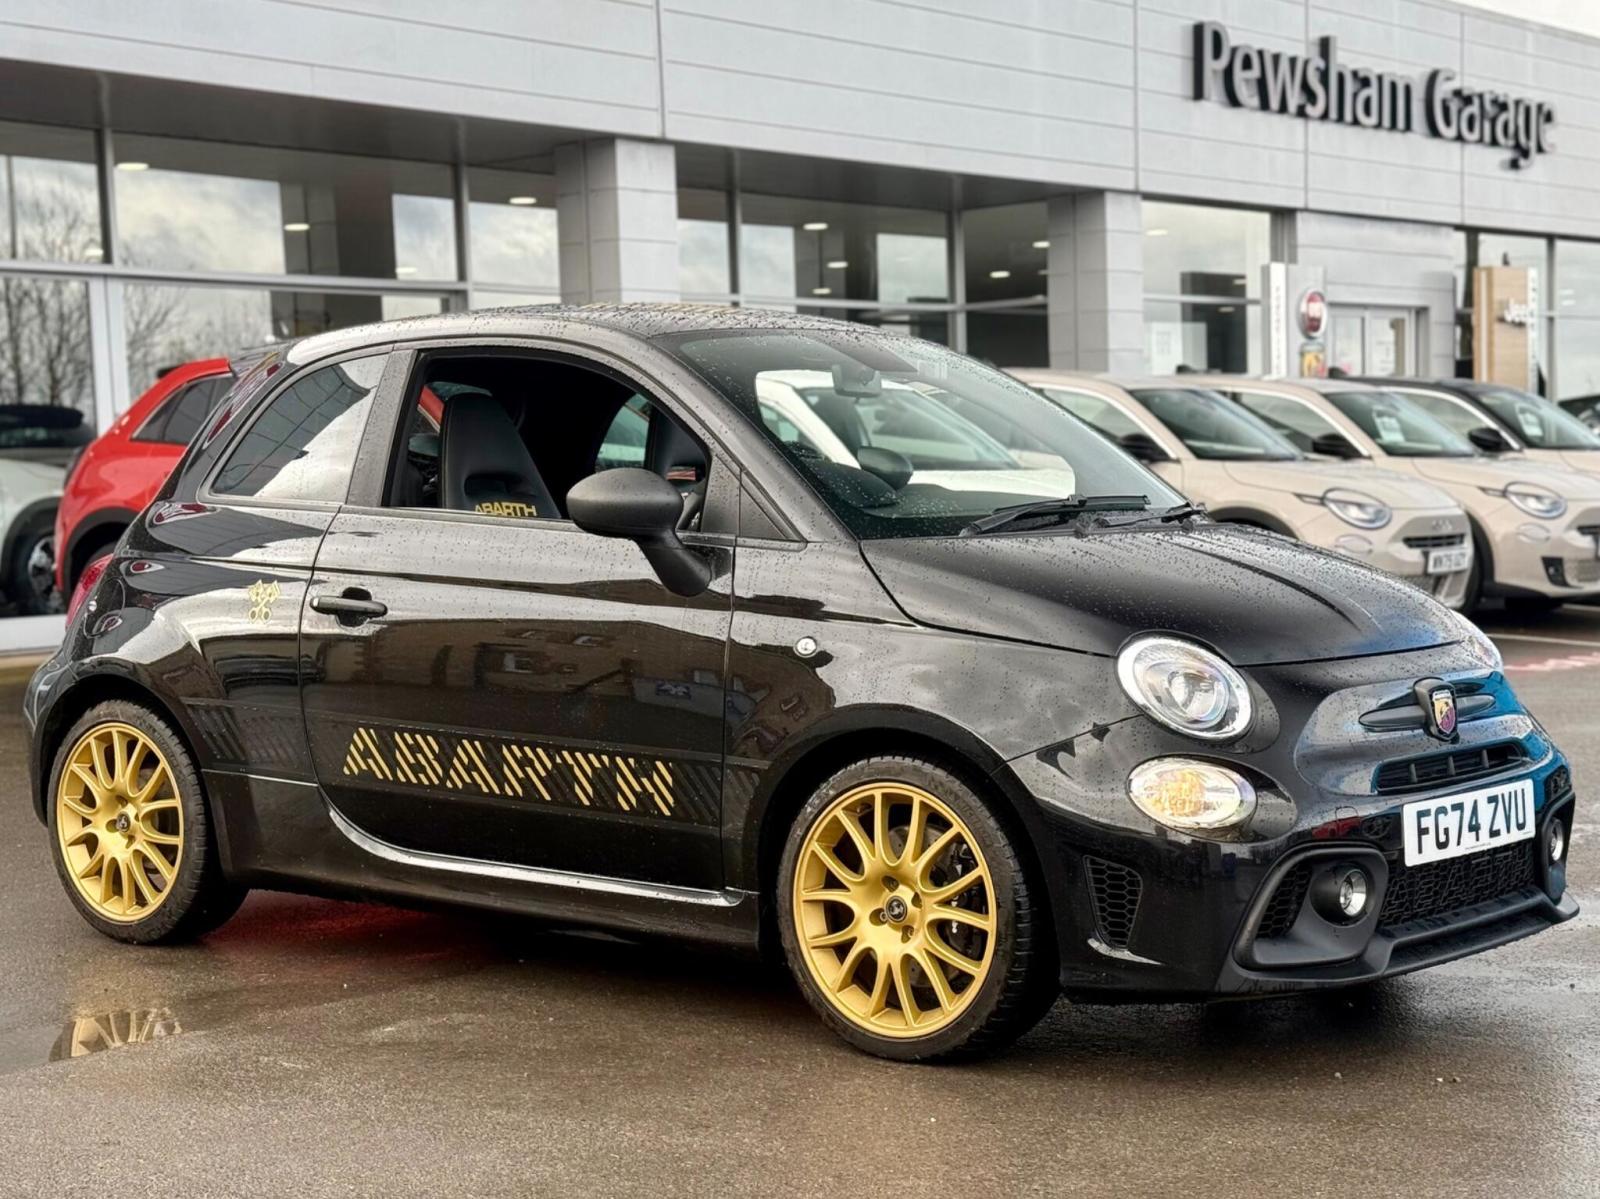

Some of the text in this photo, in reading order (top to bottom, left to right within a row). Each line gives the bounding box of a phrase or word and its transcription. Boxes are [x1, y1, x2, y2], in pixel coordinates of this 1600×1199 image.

[1192, 21, 1557, 170] Pewsham Garage
[474, 501, 537, 517] ABARTH
[343, 727, 674, 817] ABARTH
[1416, 788, 1527, 855] FG74 ZVU
